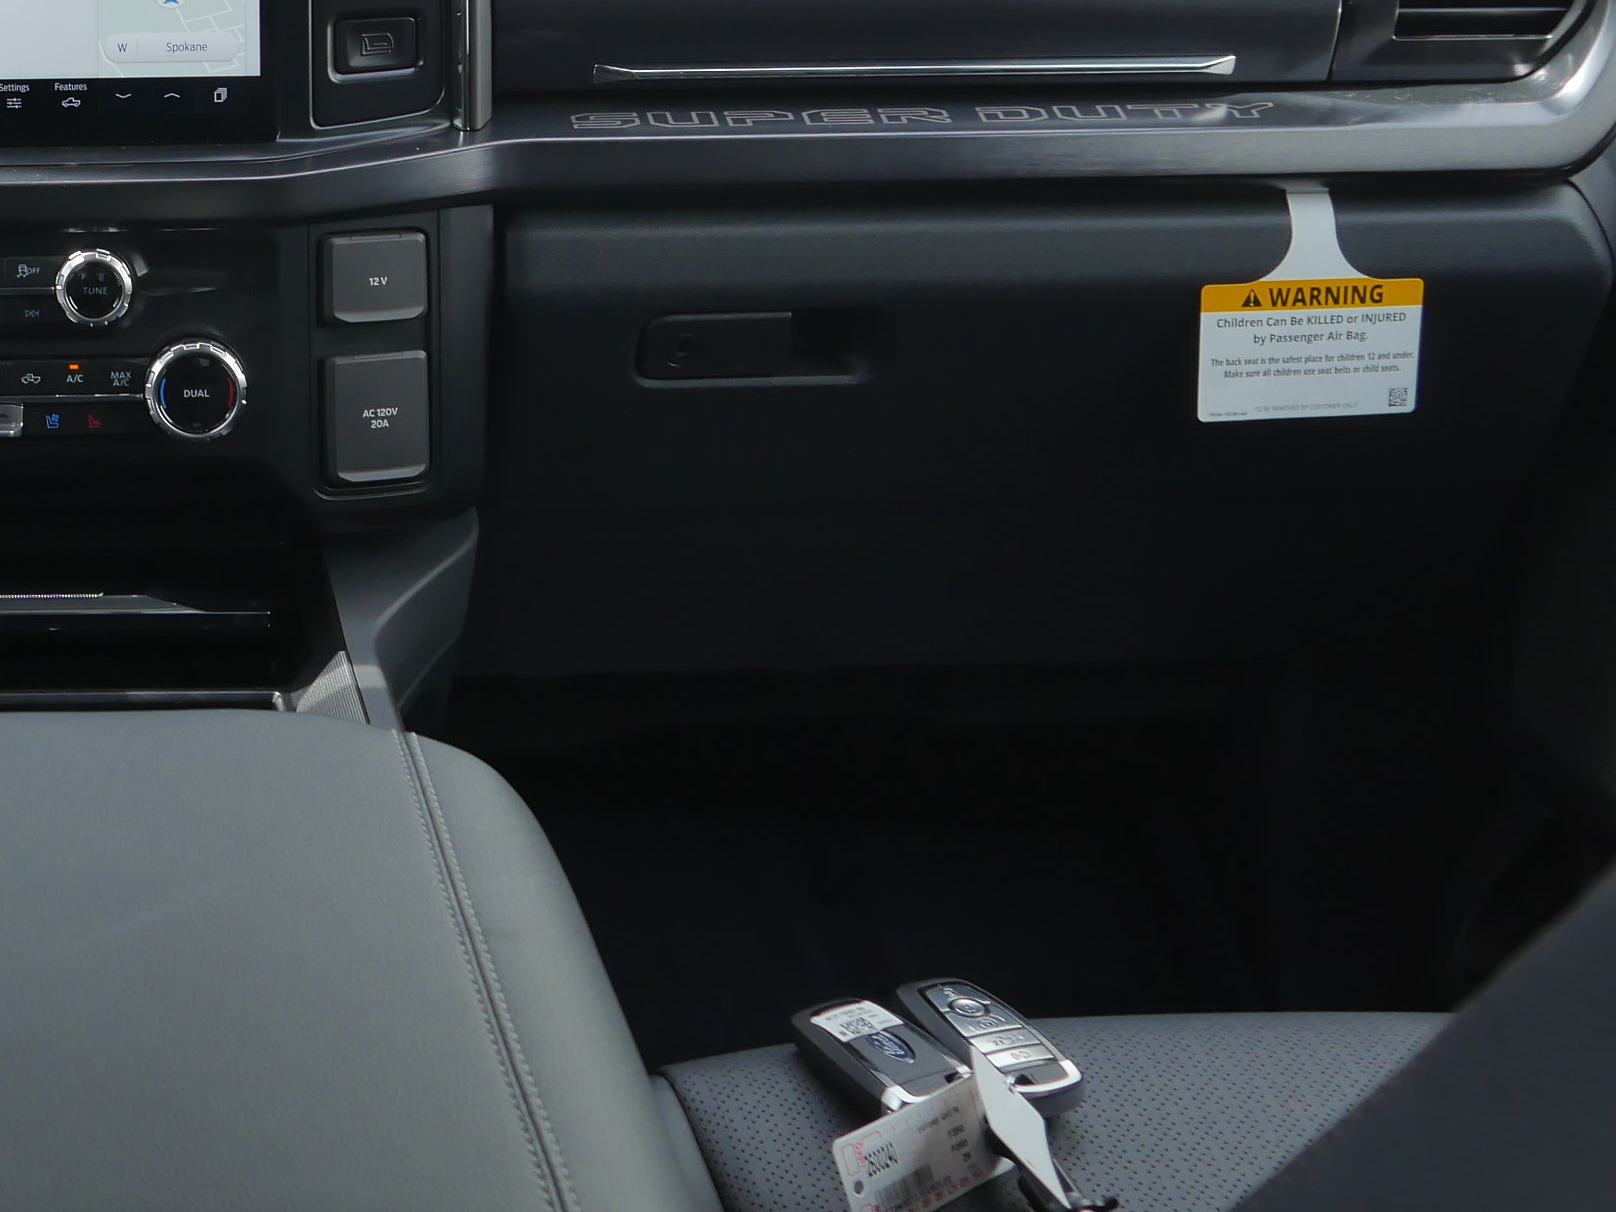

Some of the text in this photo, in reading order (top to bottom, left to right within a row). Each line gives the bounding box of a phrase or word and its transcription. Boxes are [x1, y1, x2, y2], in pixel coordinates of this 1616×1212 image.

[117, 43, 127, 52] W
[166, 42, 208, 53] Spokane
[54, 83, 88, 91] Features
[570, 101, 1274, 130] SUPER DUTY
[369, 276, 388, 286] 12 V
[82, 286, 108, 295] TUNE
[1269, 284, 1384, 307] WARNING
[1217, 312, 1407, 329] Children Can Be KILLED or INJURED
[1253, 331, 1369, 346] by Passenger Air Bag.
[1211, 358, 1224, 366] The
[1225, 357, 1242, 366] back
[1260, 357, 1267, 365] is
[1268, 356, 1280, 364] the
[1282, 355, 1303, 364] safest
[1304, 355, 1322, 364] place
[1325, 354, 1335, 362] for
[1337, 353, 1365, 362] children
[1368, 352, 1376, 360] 12
[1377, 351, 1390, 360] and
[1392, 351, 1416, 360] under.
[110, 371, 131, 380] MAX
[1224, 370, 1244, 378] Make
[1246, 370, 1261, 378] sure
[1262, 369, 1272, 377] all
[1273, 368, 1302, 377] children
[1317, 367, 1333, 375] seat
[1334, 366, 1351, 374] belts
[1362, 364, 1379, 372] child
[66, 374, 83, 383] A/C
[113, 379, 130, 387] A/C
[183, 388, 210, 398] DUAL
[363, 407, 398, 418] AC 120V
[370, 419, 390, 428] 20A
